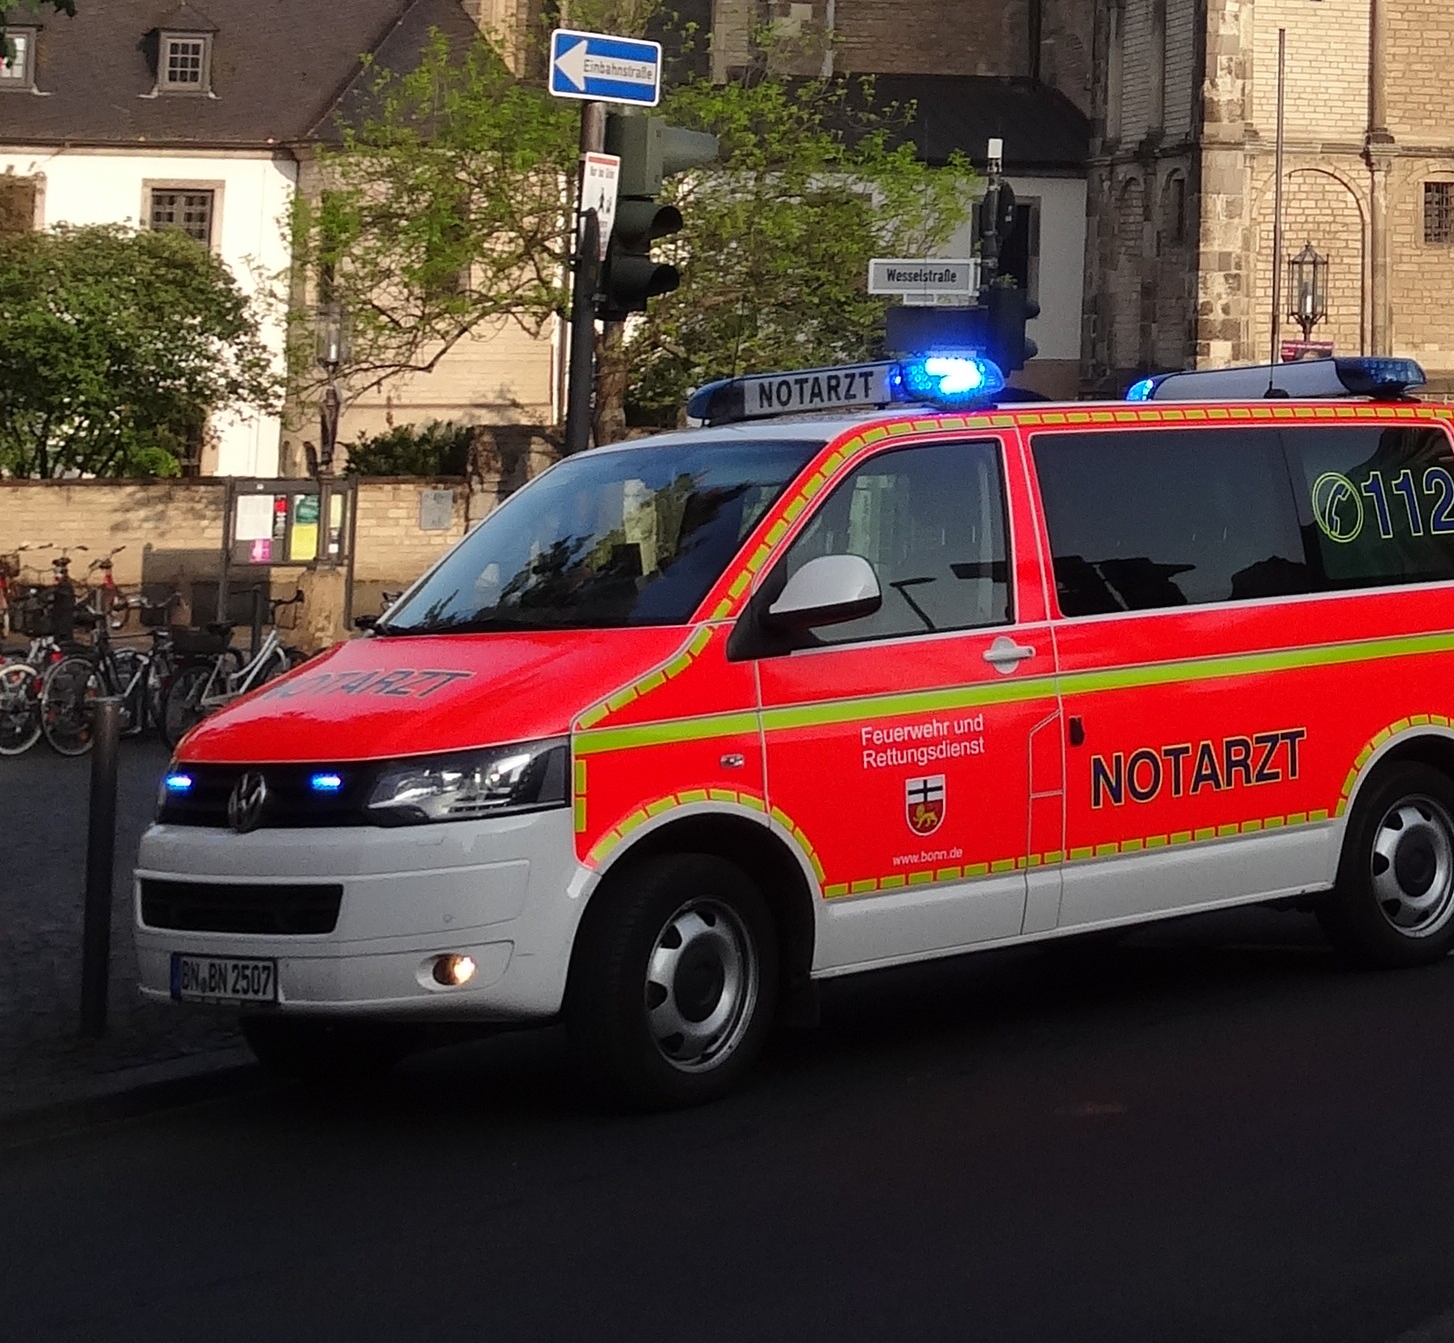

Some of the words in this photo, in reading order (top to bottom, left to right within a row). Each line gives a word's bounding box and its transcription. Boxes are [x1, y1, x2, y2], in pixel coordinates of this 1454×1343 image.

[583, 58, 653, 80] Einbahnstraße
[886, 267, 957, 283] Wesselstraße
[759, 370, 874, 409] NOTARZT
[861, 718, 949, 746] Feuerwehr
[953, 713, 984, 734] und
[863, 736, 985, 769] Rettungsdienst
[1091, 727, 1307, 809] NOTARZT
[892, 847, 963, 866] www.bonn.de
[182, 960, 200, 991] BN
[208, 963, 228, 993] BN
[231, 963, 272, 996] 2507
